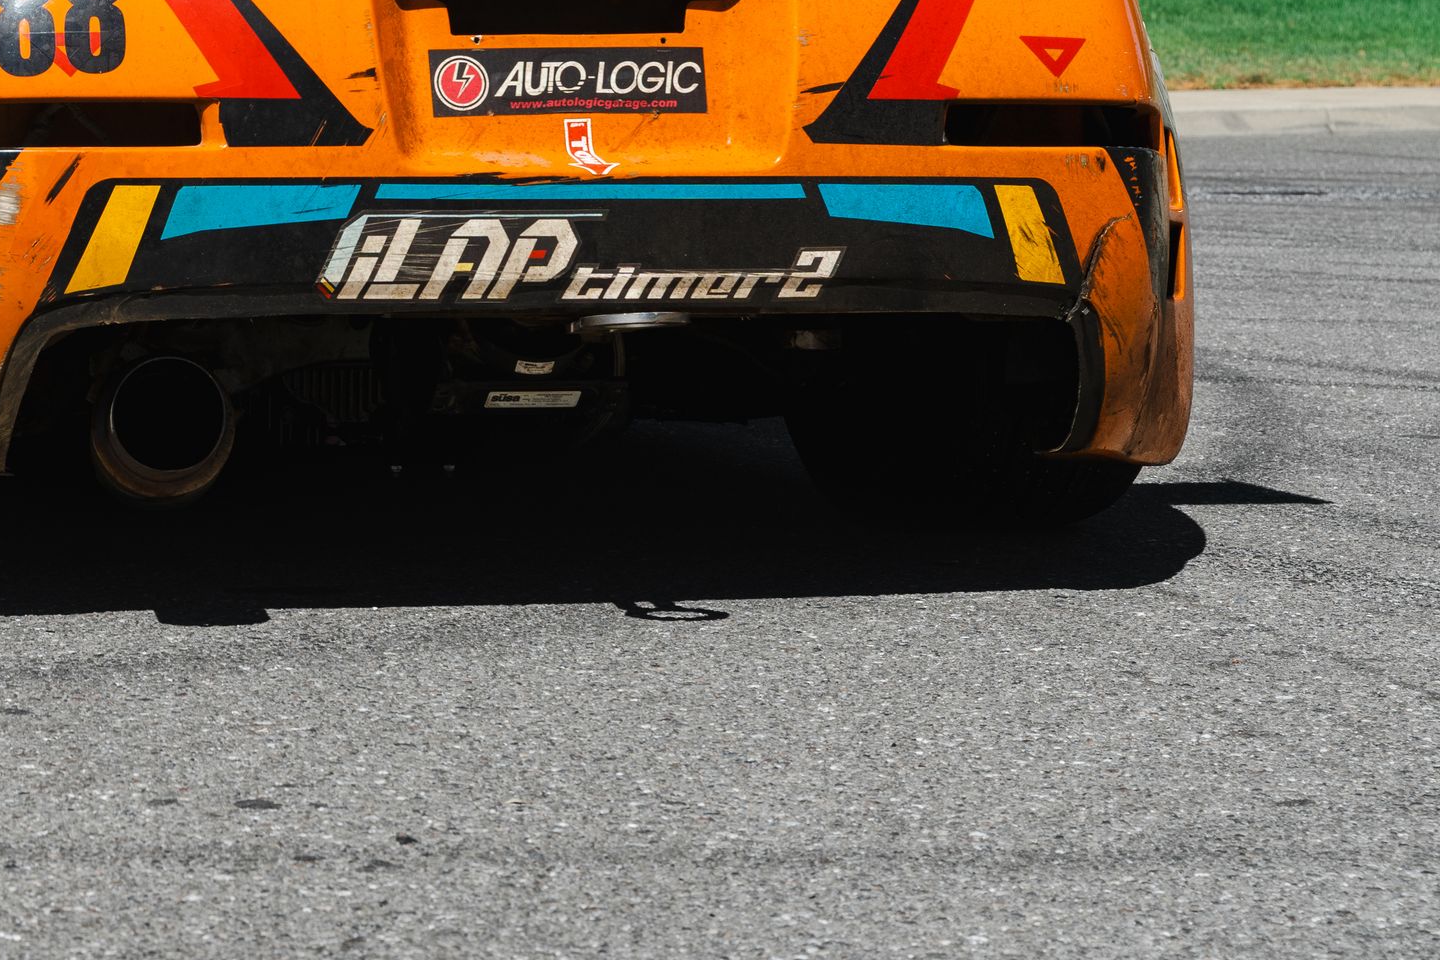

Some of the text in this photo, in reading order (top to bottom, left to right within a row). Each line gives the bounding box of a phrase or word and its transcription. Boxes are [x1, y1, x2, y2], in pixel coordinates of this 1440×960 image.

[494, 60, 702, 98] AUTO-LOGIC
[509, 97, 679, 110] www.autologicgarage.com
[561, 250, 842, 301] timer2
